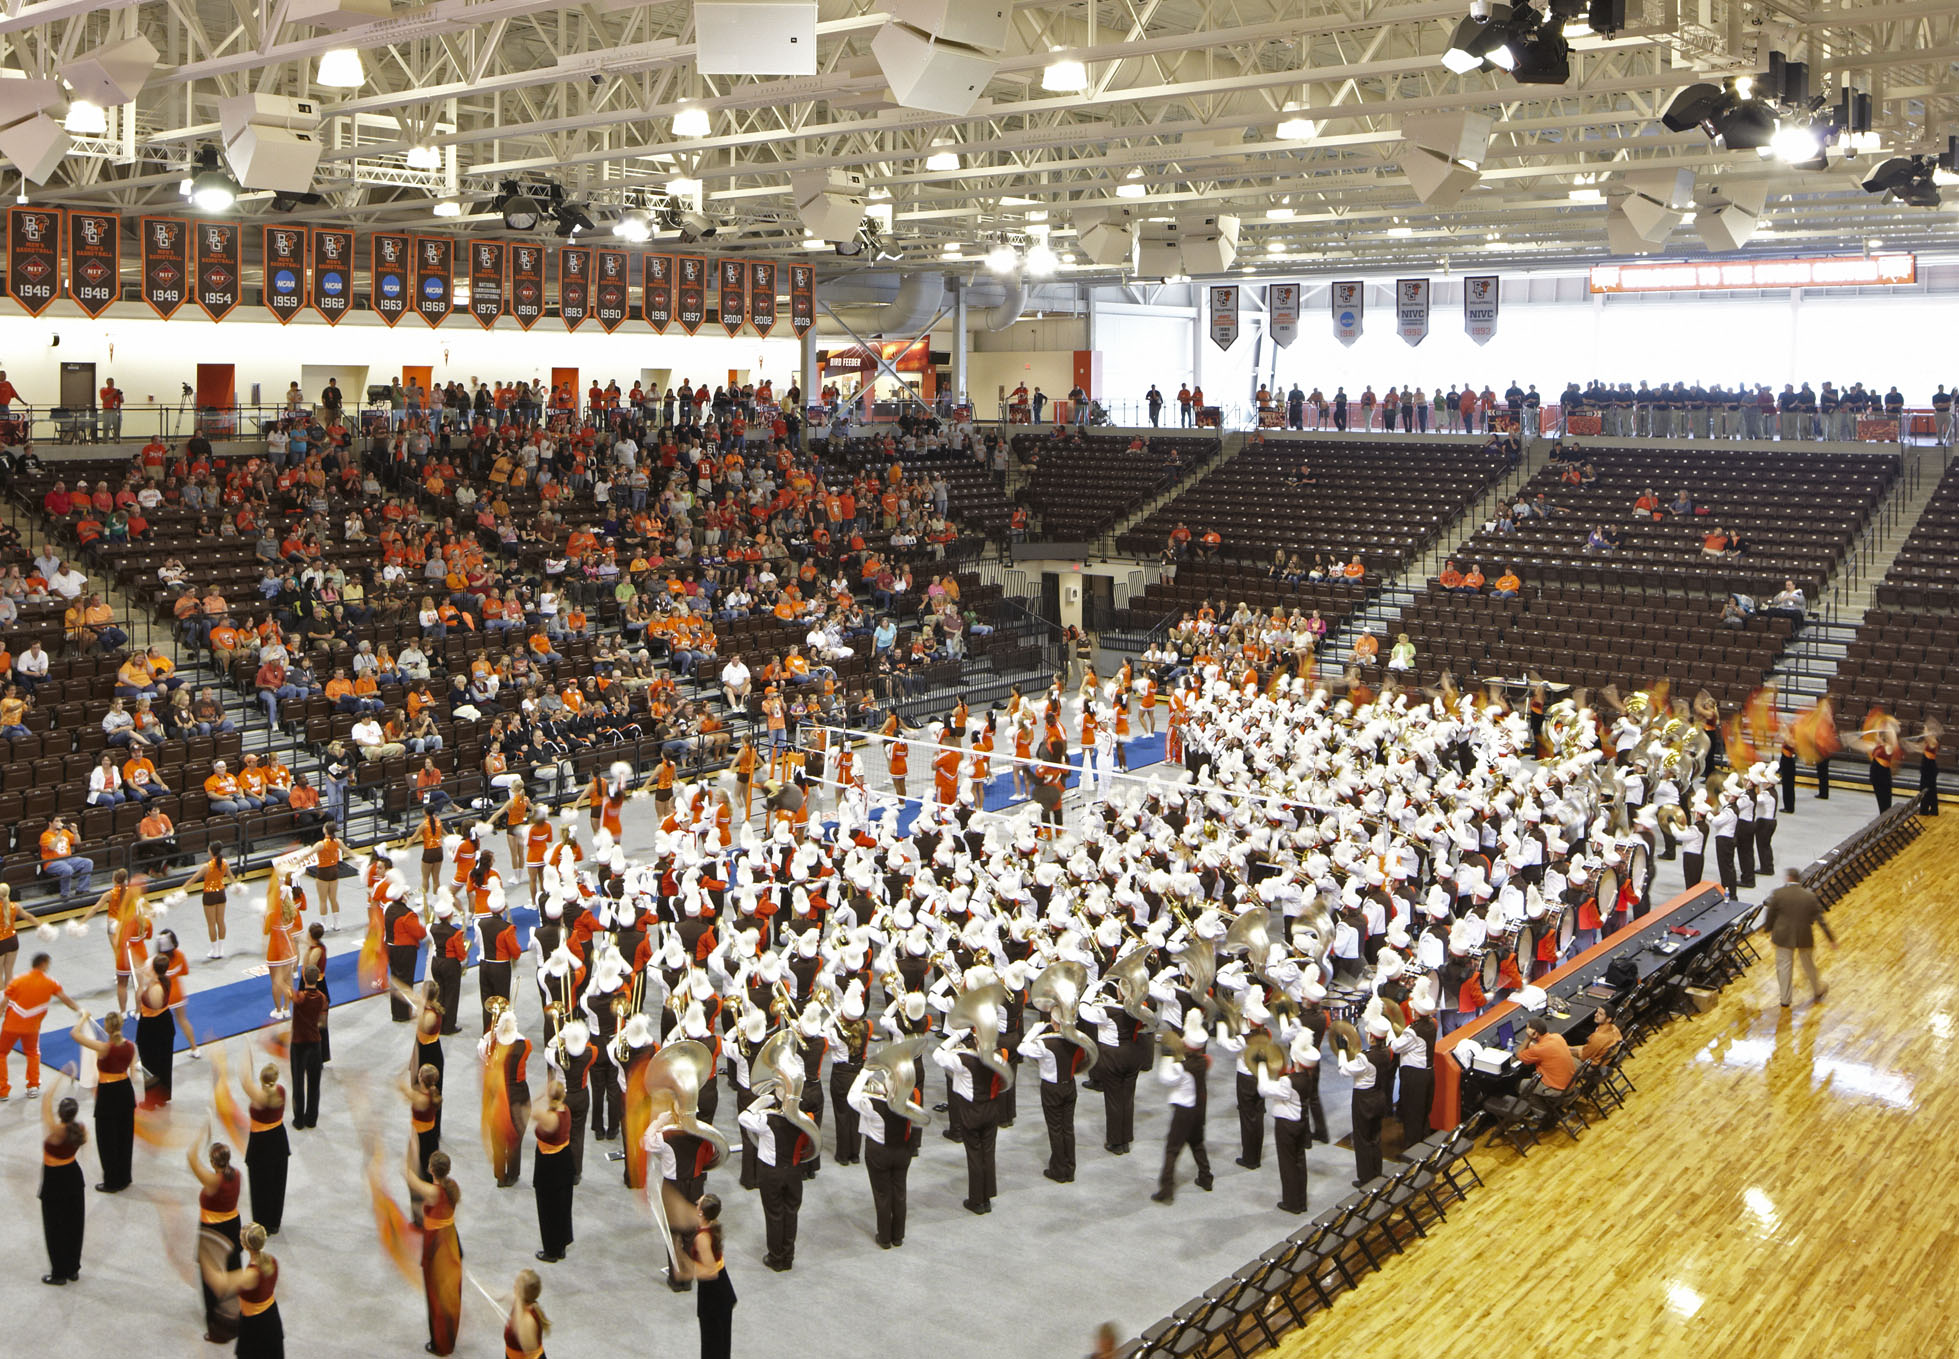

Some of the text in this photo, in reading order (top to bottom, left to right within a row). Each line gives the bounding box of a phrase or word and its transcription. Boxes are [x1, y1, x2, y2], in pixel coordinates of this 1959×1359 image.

[277, 280, 295, 288] NCAA
[20, 285, 50, 297] 1946
[80, 287, 109, 299] 1948
[153, 290, 178, 301] 1949
[205, 293, 232, 304] 1954
[273, 296, 298, 307] 1959
[321, 297, 345, 308] 1962
[380, 299, 402, 310] 1963
[422, 301, 445, 312] 1968
[477, 303, 497, 314] 1975
[518, 305, 538, 315] 1980
[565, 307, 583, 317] 1983
[600, 309, 621, 319] 1990
[1401, 310, 1425, 318] NIVC
[1469, 309, 1493, 318] NIVC
[652, 311, 667, 321] 1991
[683, 312, 700, 321] 1997
[724, 314, 742, 324] 2000
[754, 316, 772, 325] 2002
[794, 317, 811, 326] 2009
[830, 357, 861, 367] BIRD FEEDER
[707, 445, 716, 454] 61
[701, 464, 710, 474] 13
